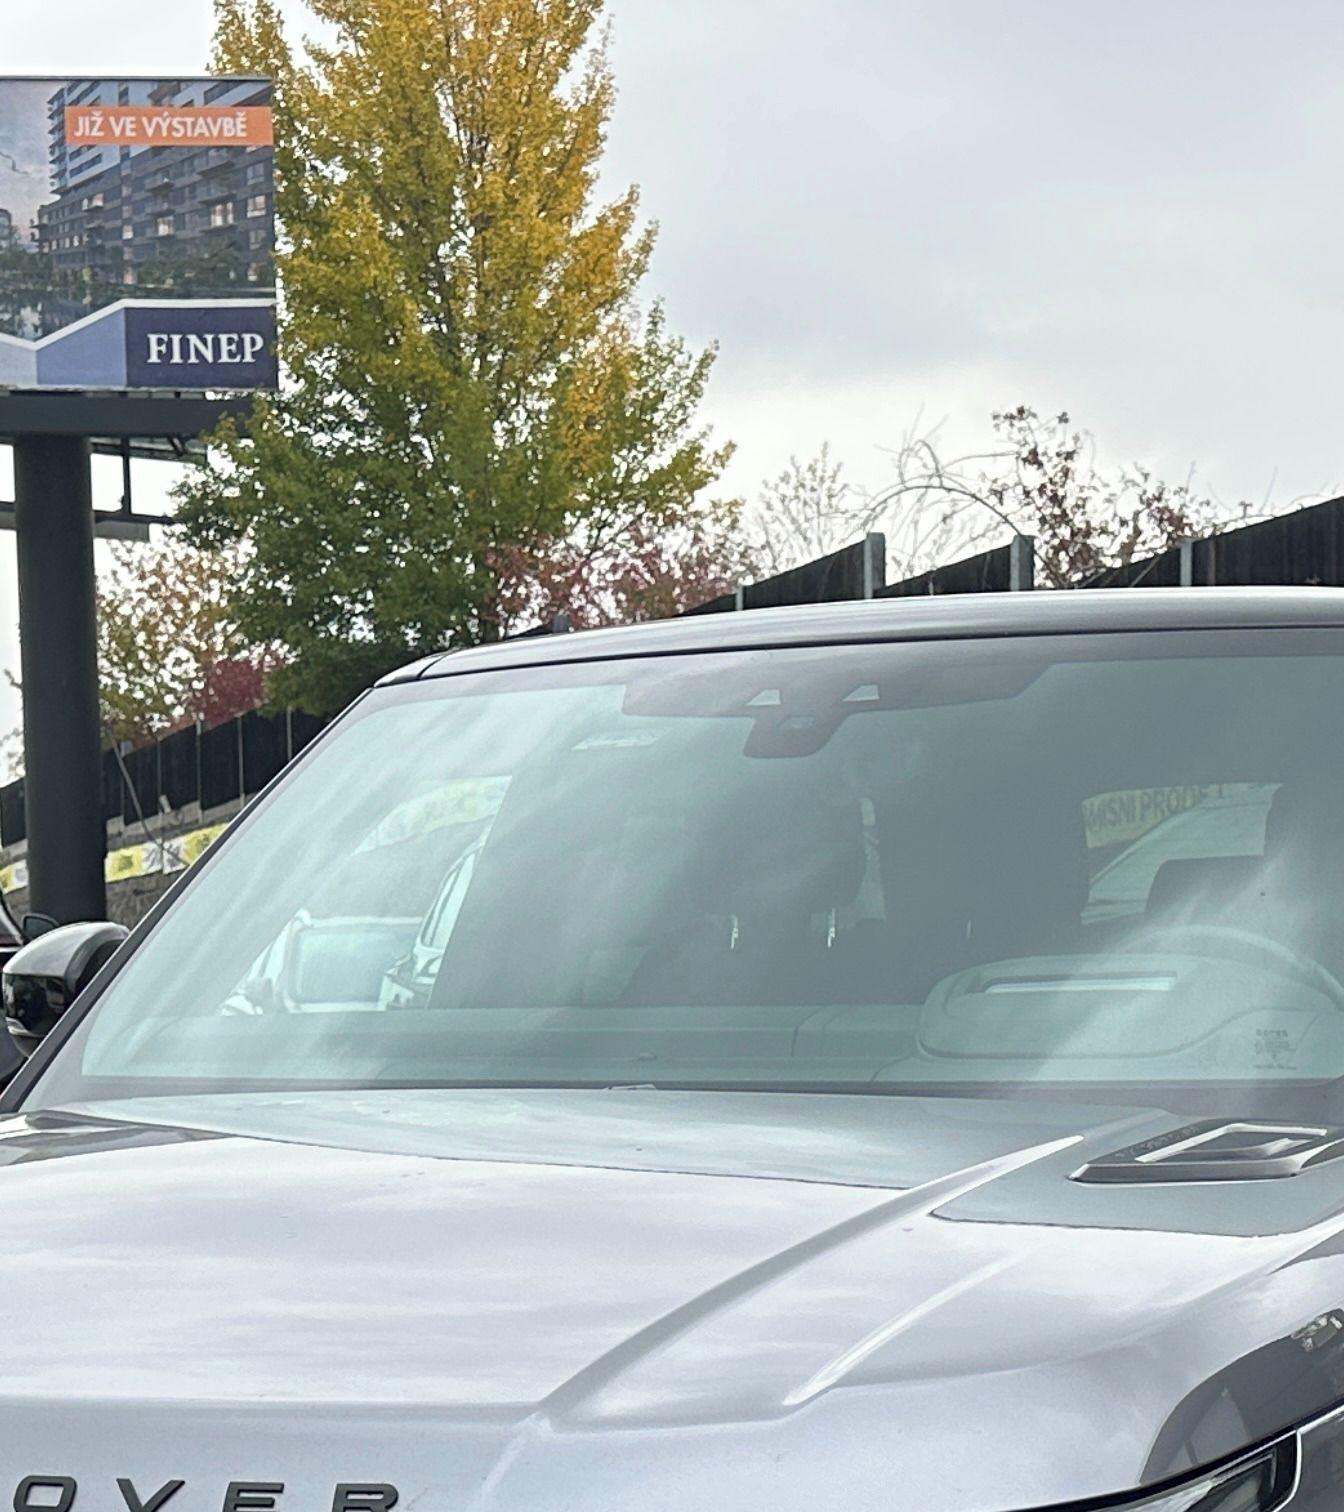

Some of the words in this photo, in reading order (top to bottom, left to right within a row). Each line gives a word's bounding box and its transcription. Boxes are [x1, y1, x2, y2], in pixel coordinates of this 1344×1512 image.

[74, 111, 104, 137] JIŽ
[109, 116, 136, 137] VE
[142, 112, 248, 138] VÝSTAVBĚ
[146, 332, 264, 364] FINEP
